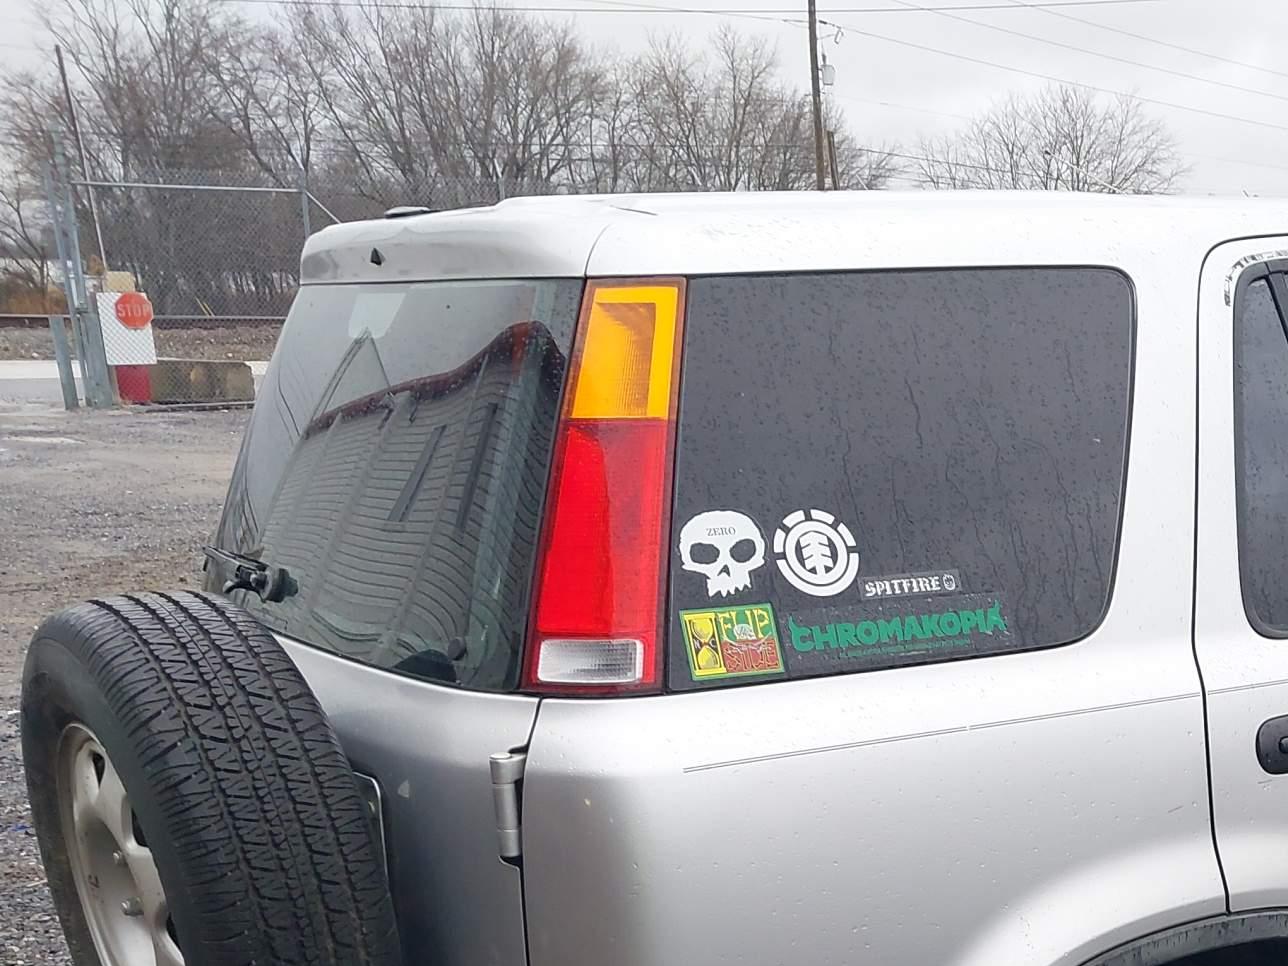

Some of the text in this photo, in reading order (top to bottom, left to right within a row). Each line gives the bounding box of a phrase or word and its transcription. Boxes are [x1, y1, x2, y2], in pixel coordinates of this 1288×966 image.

[117, 303, 150, 317] STOP
[705, 526, 737, 537] ZERO
[865, 576, 941, 597] SPITFIRE
[788, 600, 1007, 652] CHROMAKOPIA
